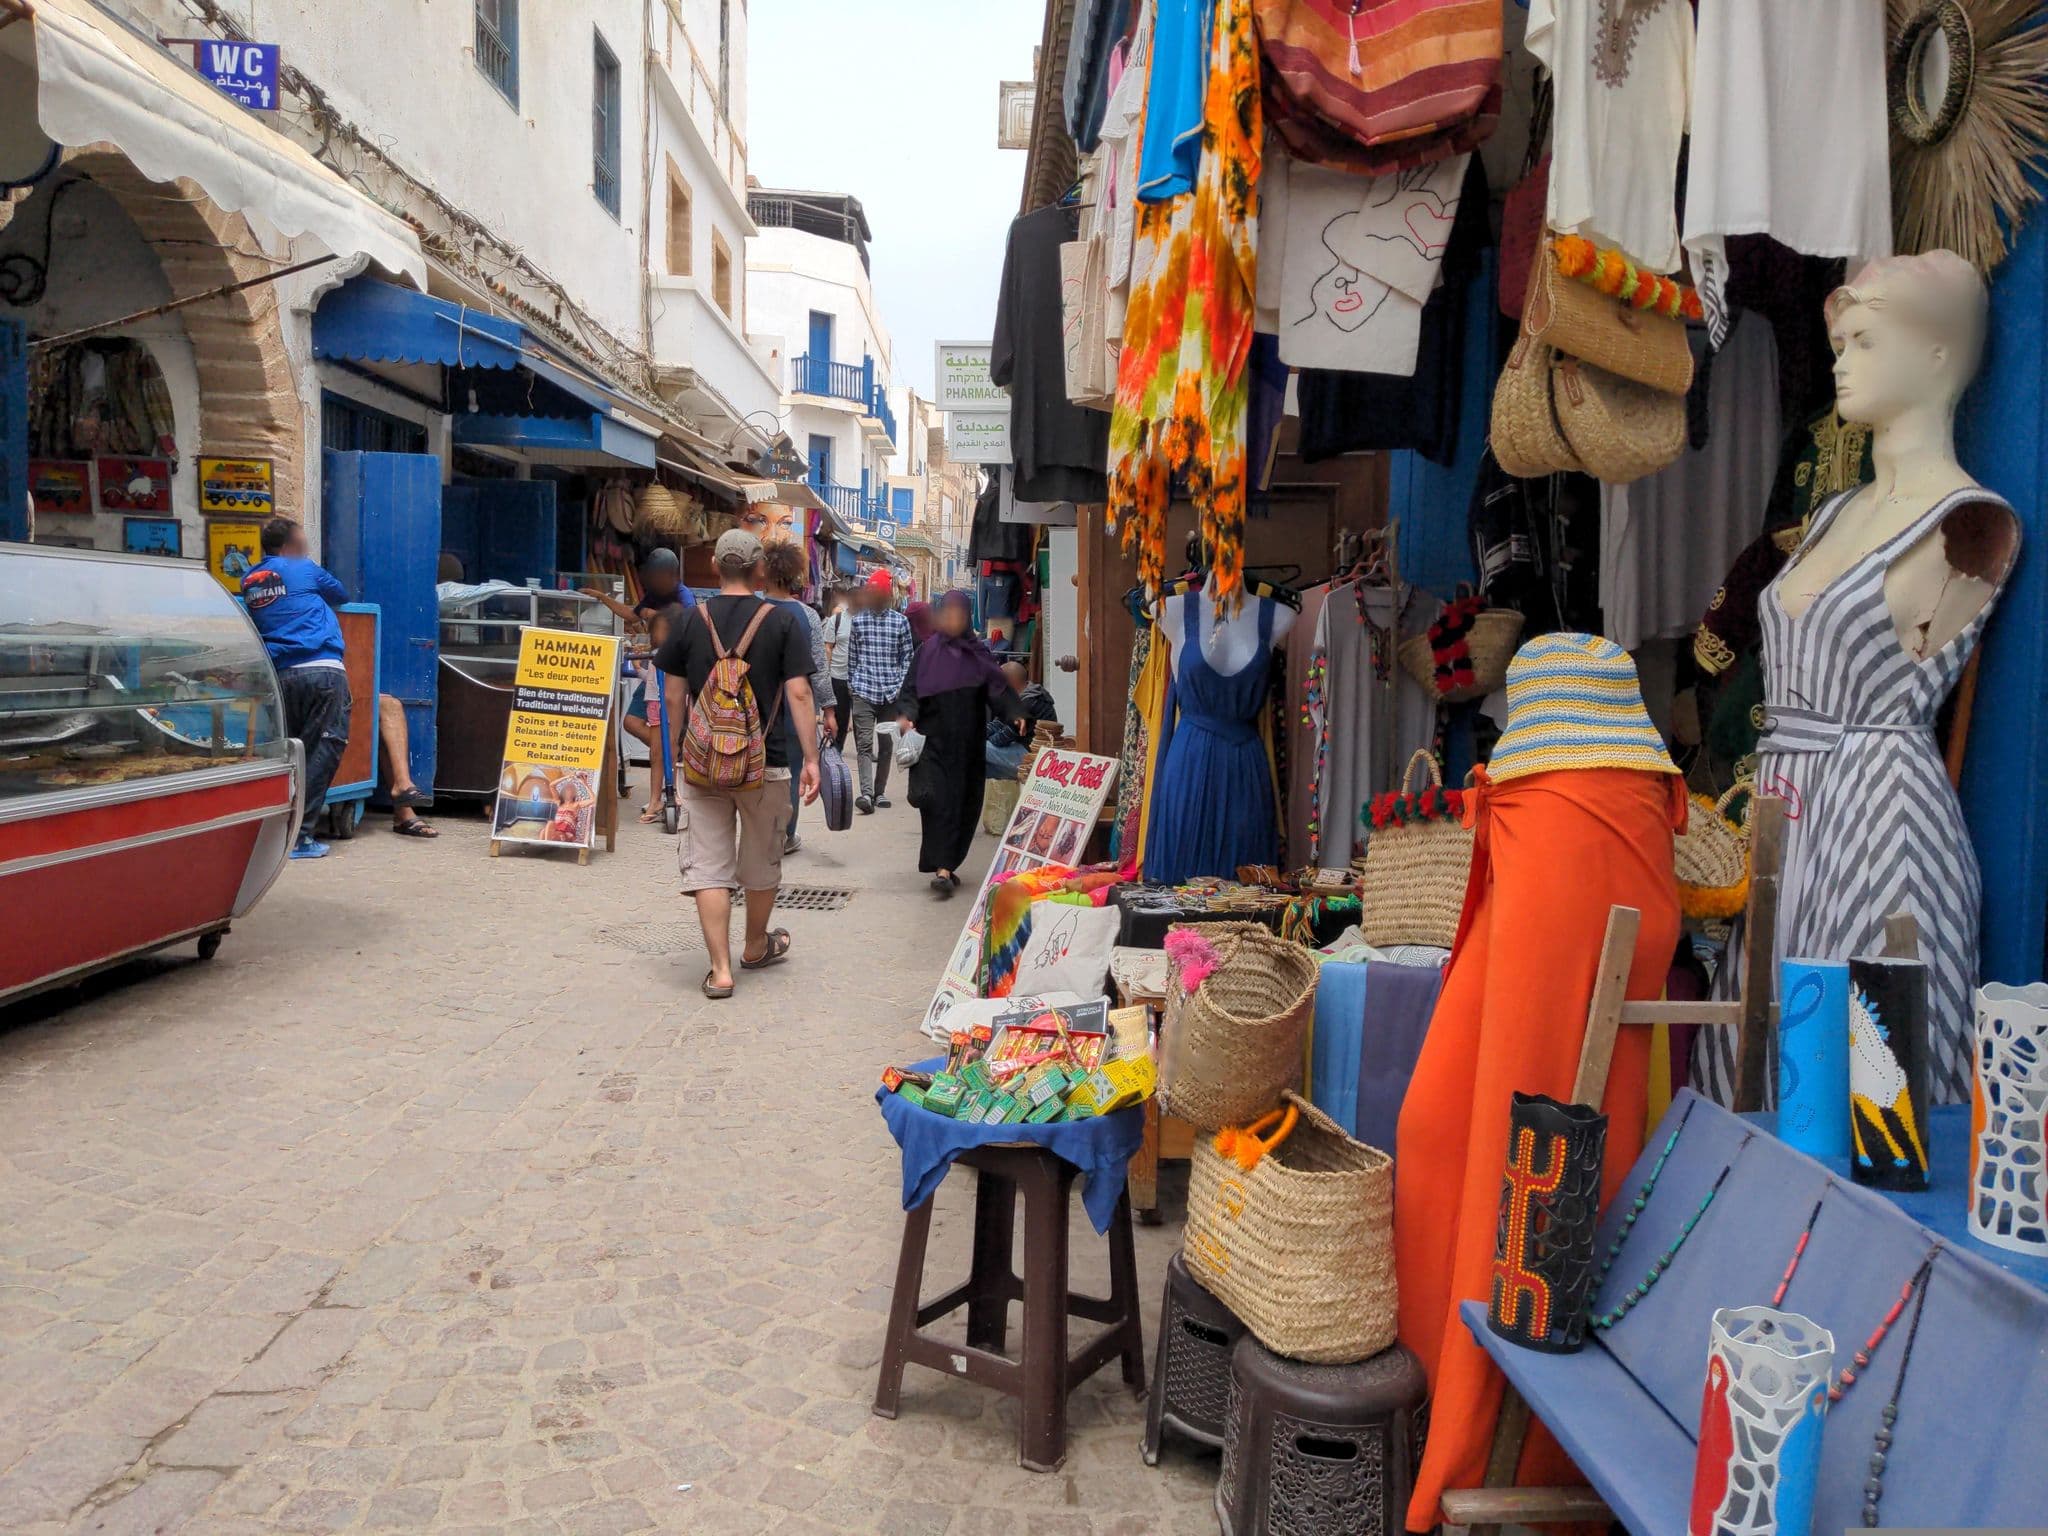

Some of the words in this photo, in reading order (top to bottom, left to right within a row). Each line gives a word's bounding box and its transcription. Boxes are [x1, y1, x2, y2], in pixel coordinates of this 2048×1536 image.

[211, 44, 263, 76] WC
[216, 74, 262, 90] مرحاض
[945, 352, 991, 371] يدلية
[946, 388, 1008, 399] PHARMACIE
[956, 419, 1004, 435] صيدلية
[534, 639, 602, 657] HAMMAM
[536, 654, 595, 670] MOUNIA
[547, 671, 569, 681] deux
[518, 688, 536, 698] Bien
[538, 689, 555, 700] être
[556, 692, 604, 705] traditionnel
[516, 698, 560, 711] Traditional
[562, 704, 604, 717] well-being
[517, 715, 546, 726] Soins
[549, 719, 559, 728] et
[561, 720, 598, 731] beauté
[515, 726, 559, 738] Relaxation
[565, 731, 597, 742] détente
[514, 739, 537, 749] Care
[540, 742, 558, 751] and
[561, 743, 595, 755] beauty
[526, 751, 580, 763] Relaxation
[1035, 750, 1075, 787] Chez
